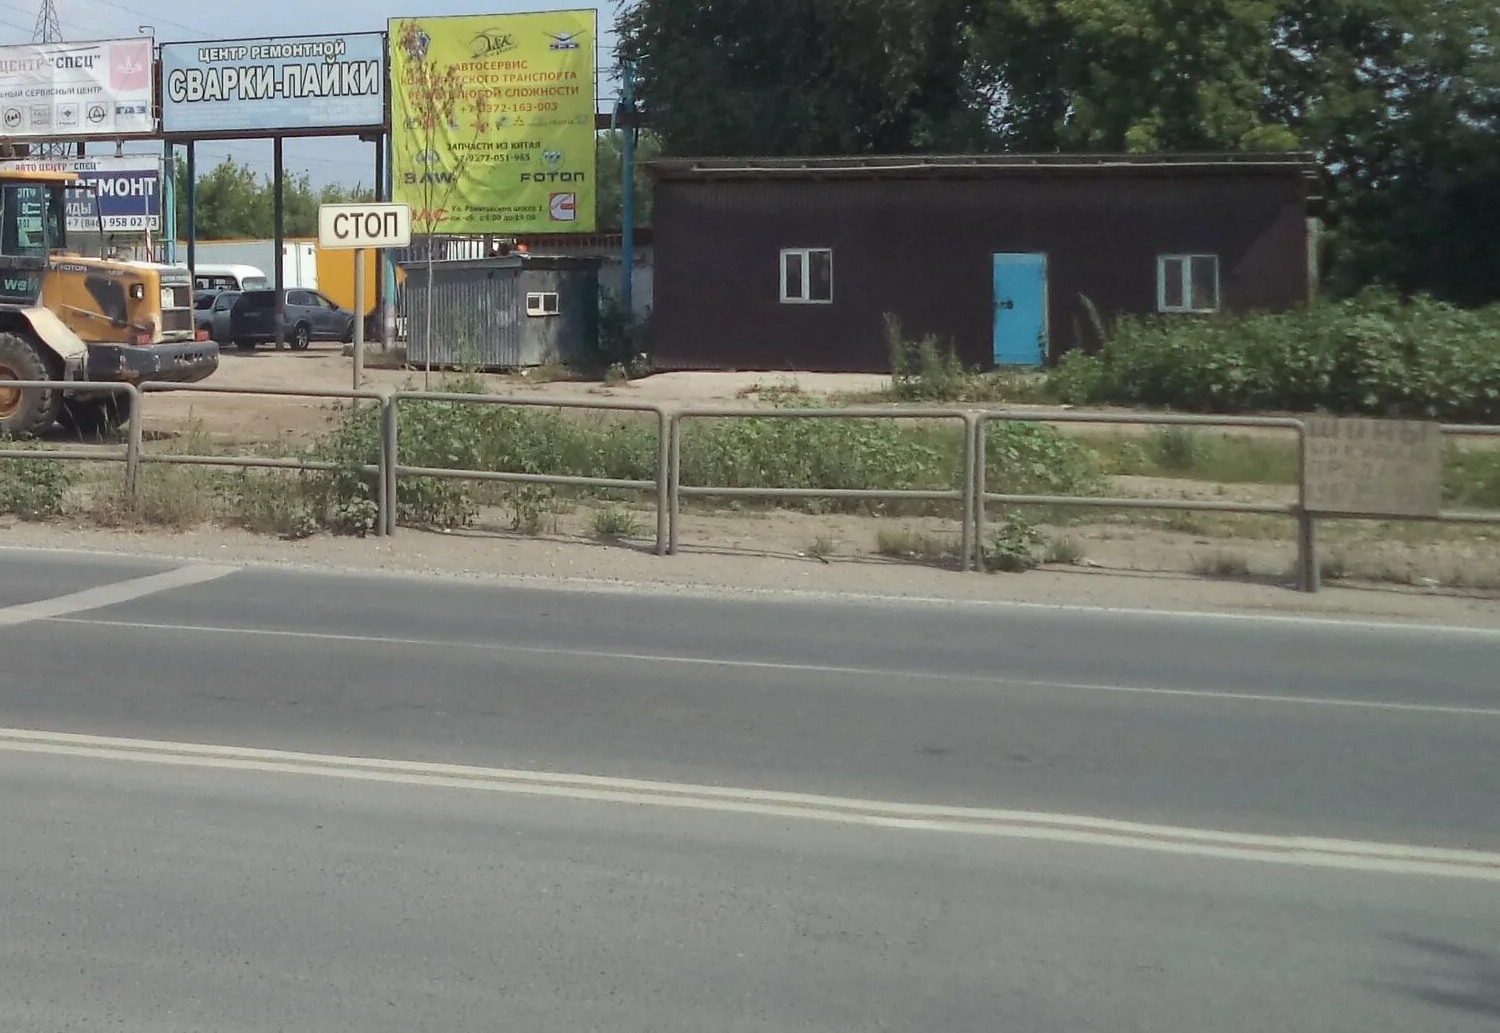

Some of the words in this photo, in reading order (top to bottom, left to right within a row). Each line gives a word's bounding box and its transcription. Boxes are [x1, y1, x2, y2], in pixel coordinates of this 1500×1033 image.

[198, 47, 247, 63] ЦЕНТР
[250, 39, 345, 59] РЕМОНТНОЙ
[0, 58, 44, 75] ЦЕНТР
[455, 60, 528, 72] АВТОСЕРВИС
[167, 56, 380, 103] СВАРКИ-ПАЙКИ
[503, 71, 577, 84] ТРАНСПОРТА
[25, 87, 76, 98] СЕРВИСНЫЙ
[76, 86, 103, 95] ЦЕНТР
[504, 86, 579, 98] СЛОЖНОСТИ
[448, 142, 493, 151] ЗАПЧАСТИ
[497, 142, 508, 150] ИЗ
[511, 141, 541, 150] КИТАЯ
[15, 162, 36, 171] АВТО
[38, 162, 67, 172] ЦЕНТР
[75, 177, 157, 199] РЕМОНТ
[110, 218, 127, 227] 958
[130, 218, 142, 227] 02
[333, 211, 399, 239] СТОП
